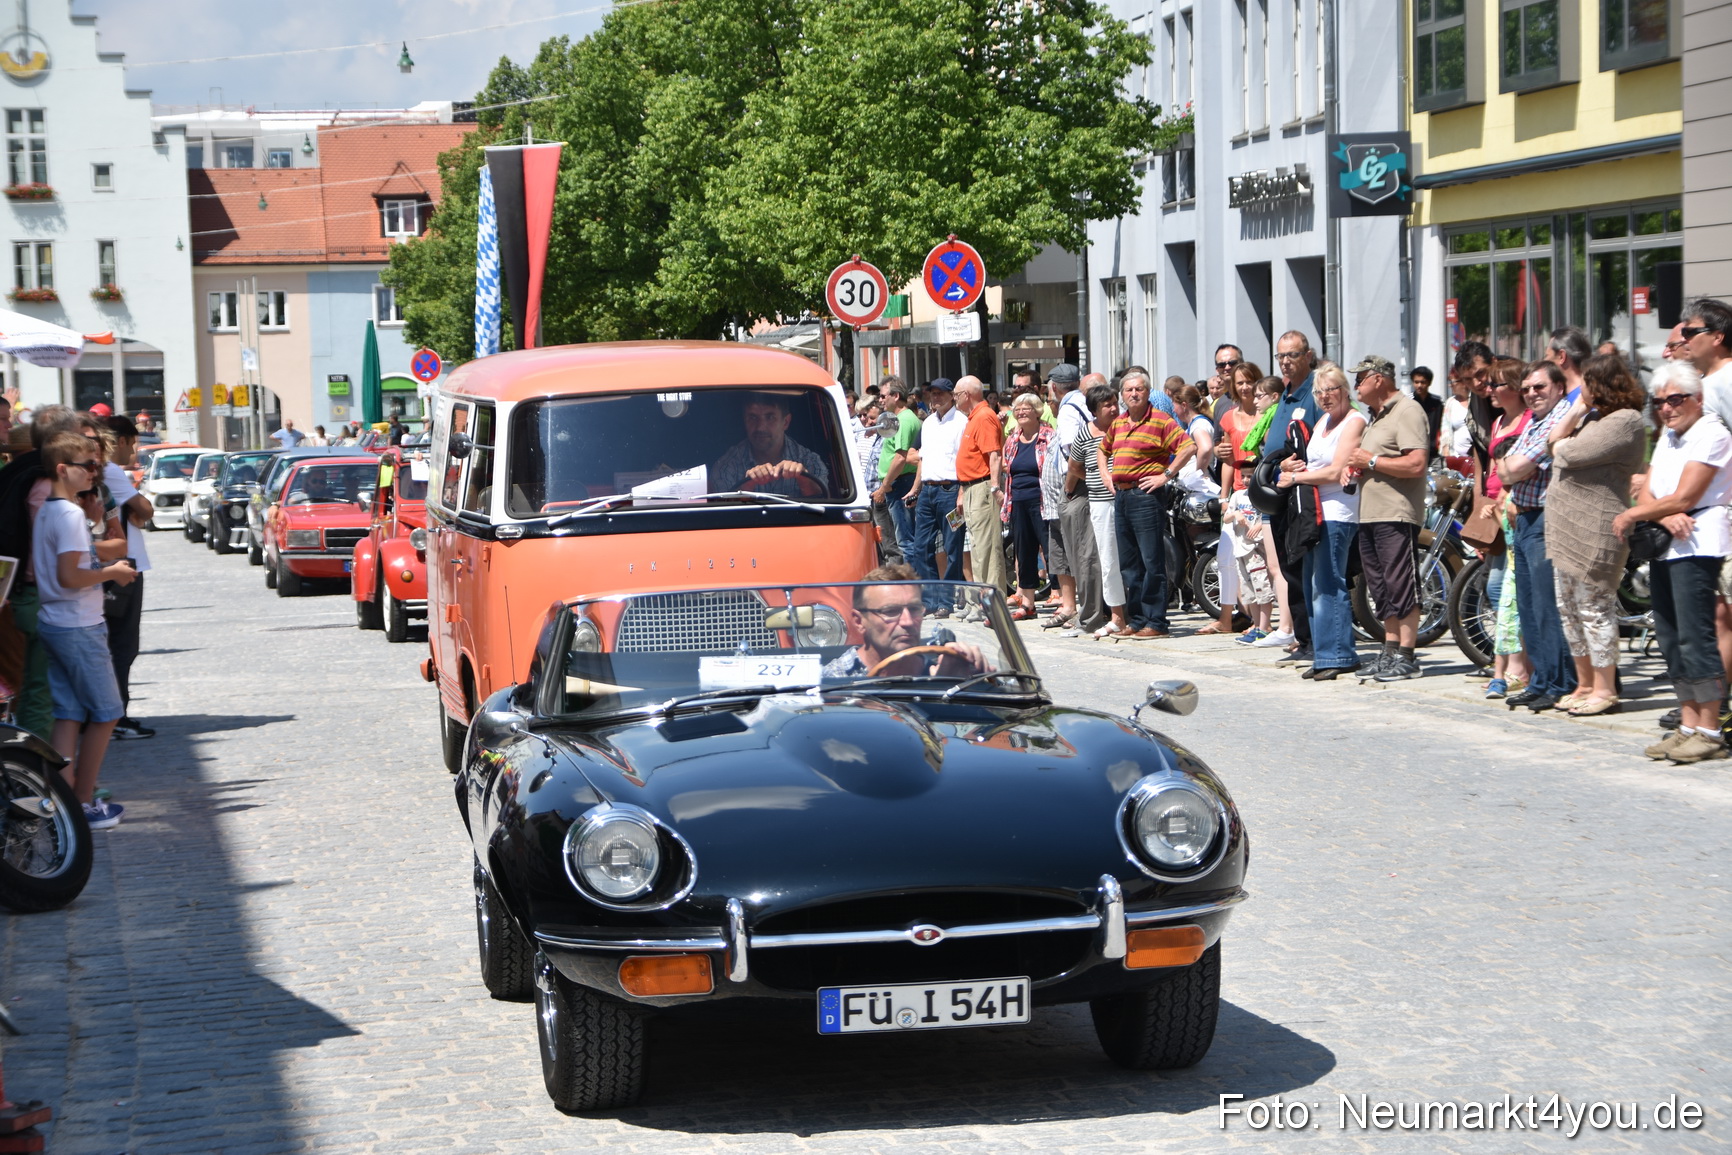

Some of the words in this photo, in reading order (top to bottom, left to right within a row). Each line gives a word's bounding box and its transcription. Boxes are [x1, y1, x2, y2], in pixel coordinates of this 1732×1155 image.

[1359, 154, 1388, 191] G2
[839, 278, 875, 308] 30
[657, 393, 666, 402] THE
[757, 663, 796, 676] 237
[843, 991, 893, 1027] FÜ
[921, 989, 940, 1023] I
[951, 983, 1024, 1022] 54H
[825, 1014, 835, 1025] D
